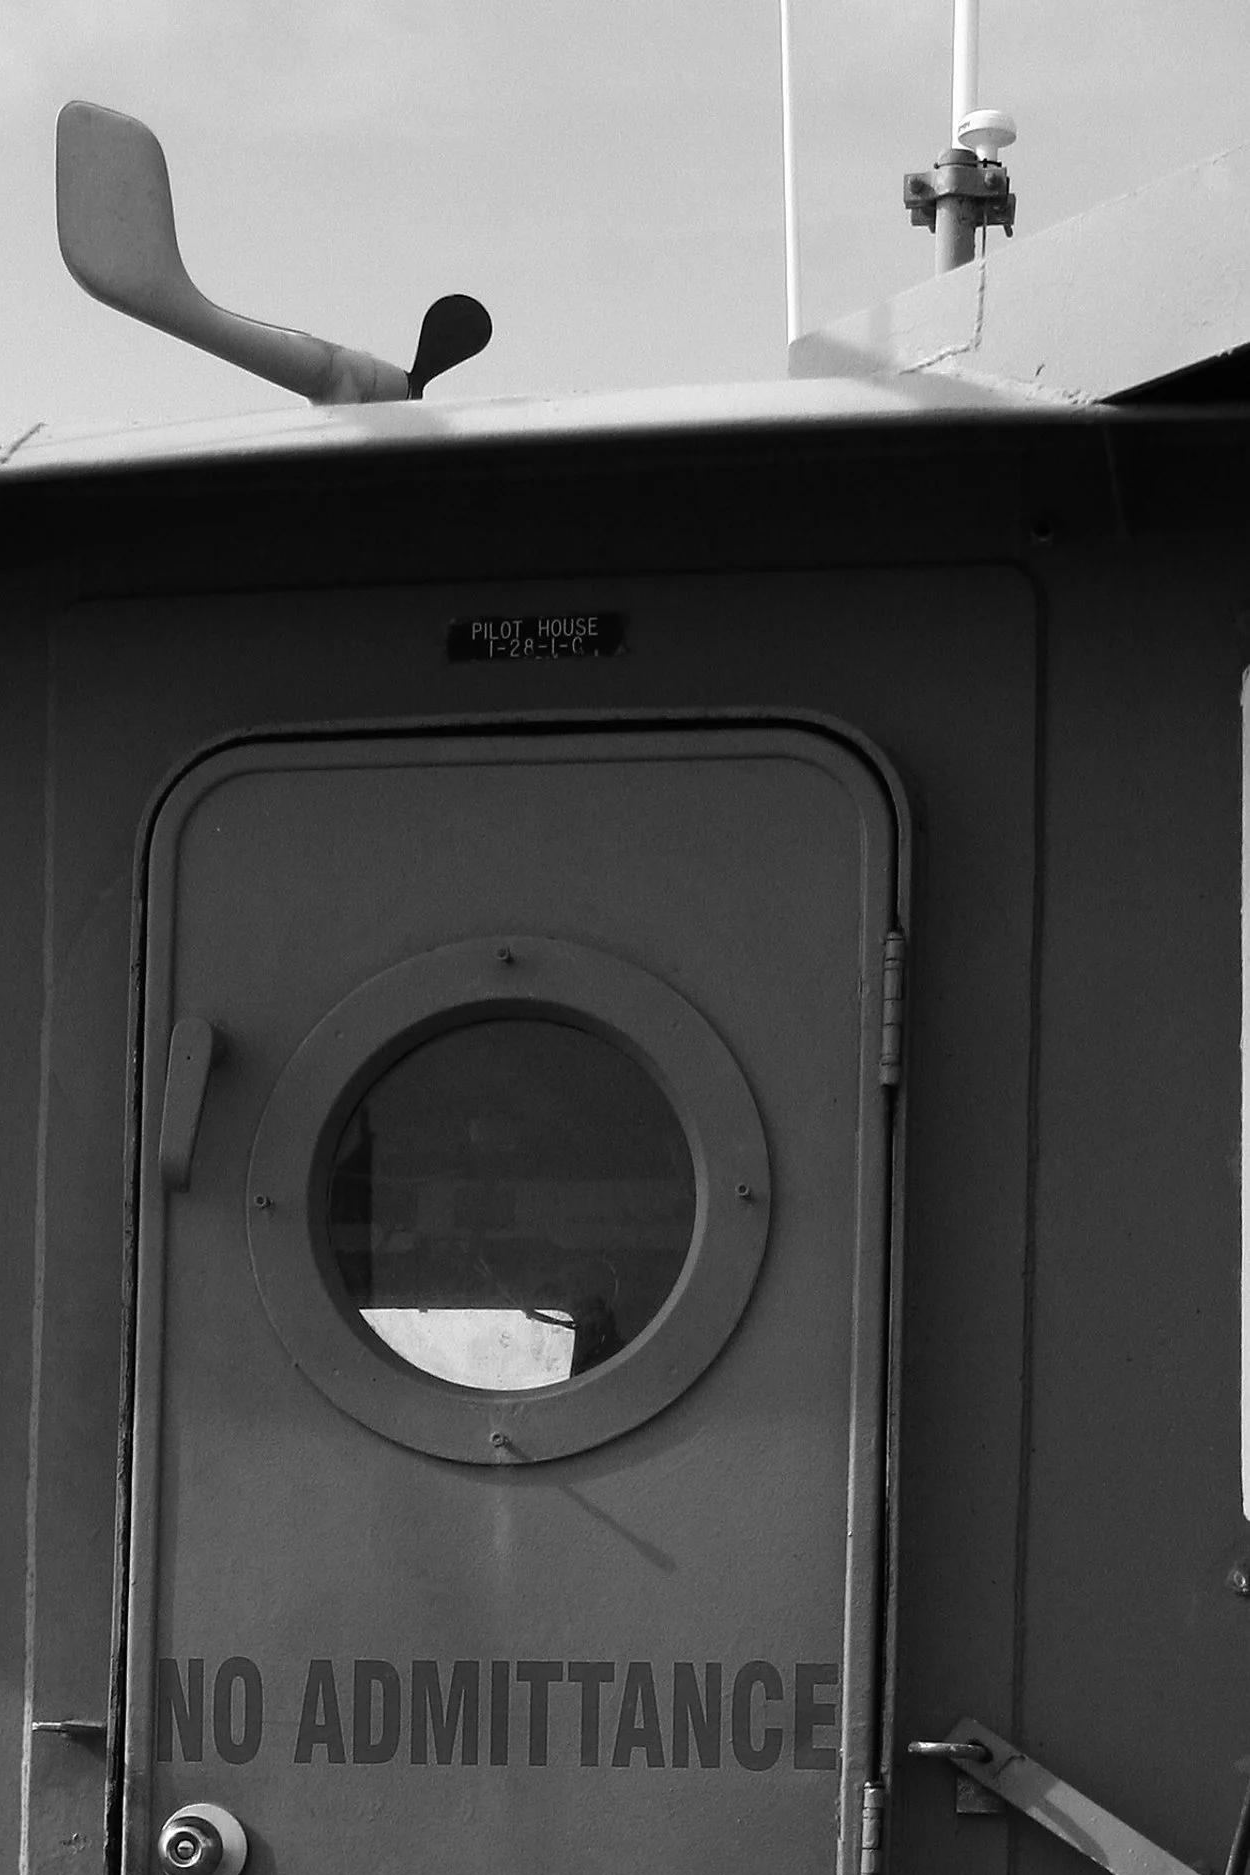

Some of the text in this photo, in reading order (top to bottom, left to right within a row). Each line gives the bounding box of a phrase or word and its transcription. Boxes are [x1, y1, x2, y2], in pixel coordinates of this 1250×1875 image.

[471, 617, 599, 641] PILOT HOUSE
[157, 1656, 839, 1772] NO ADMITTANCE
